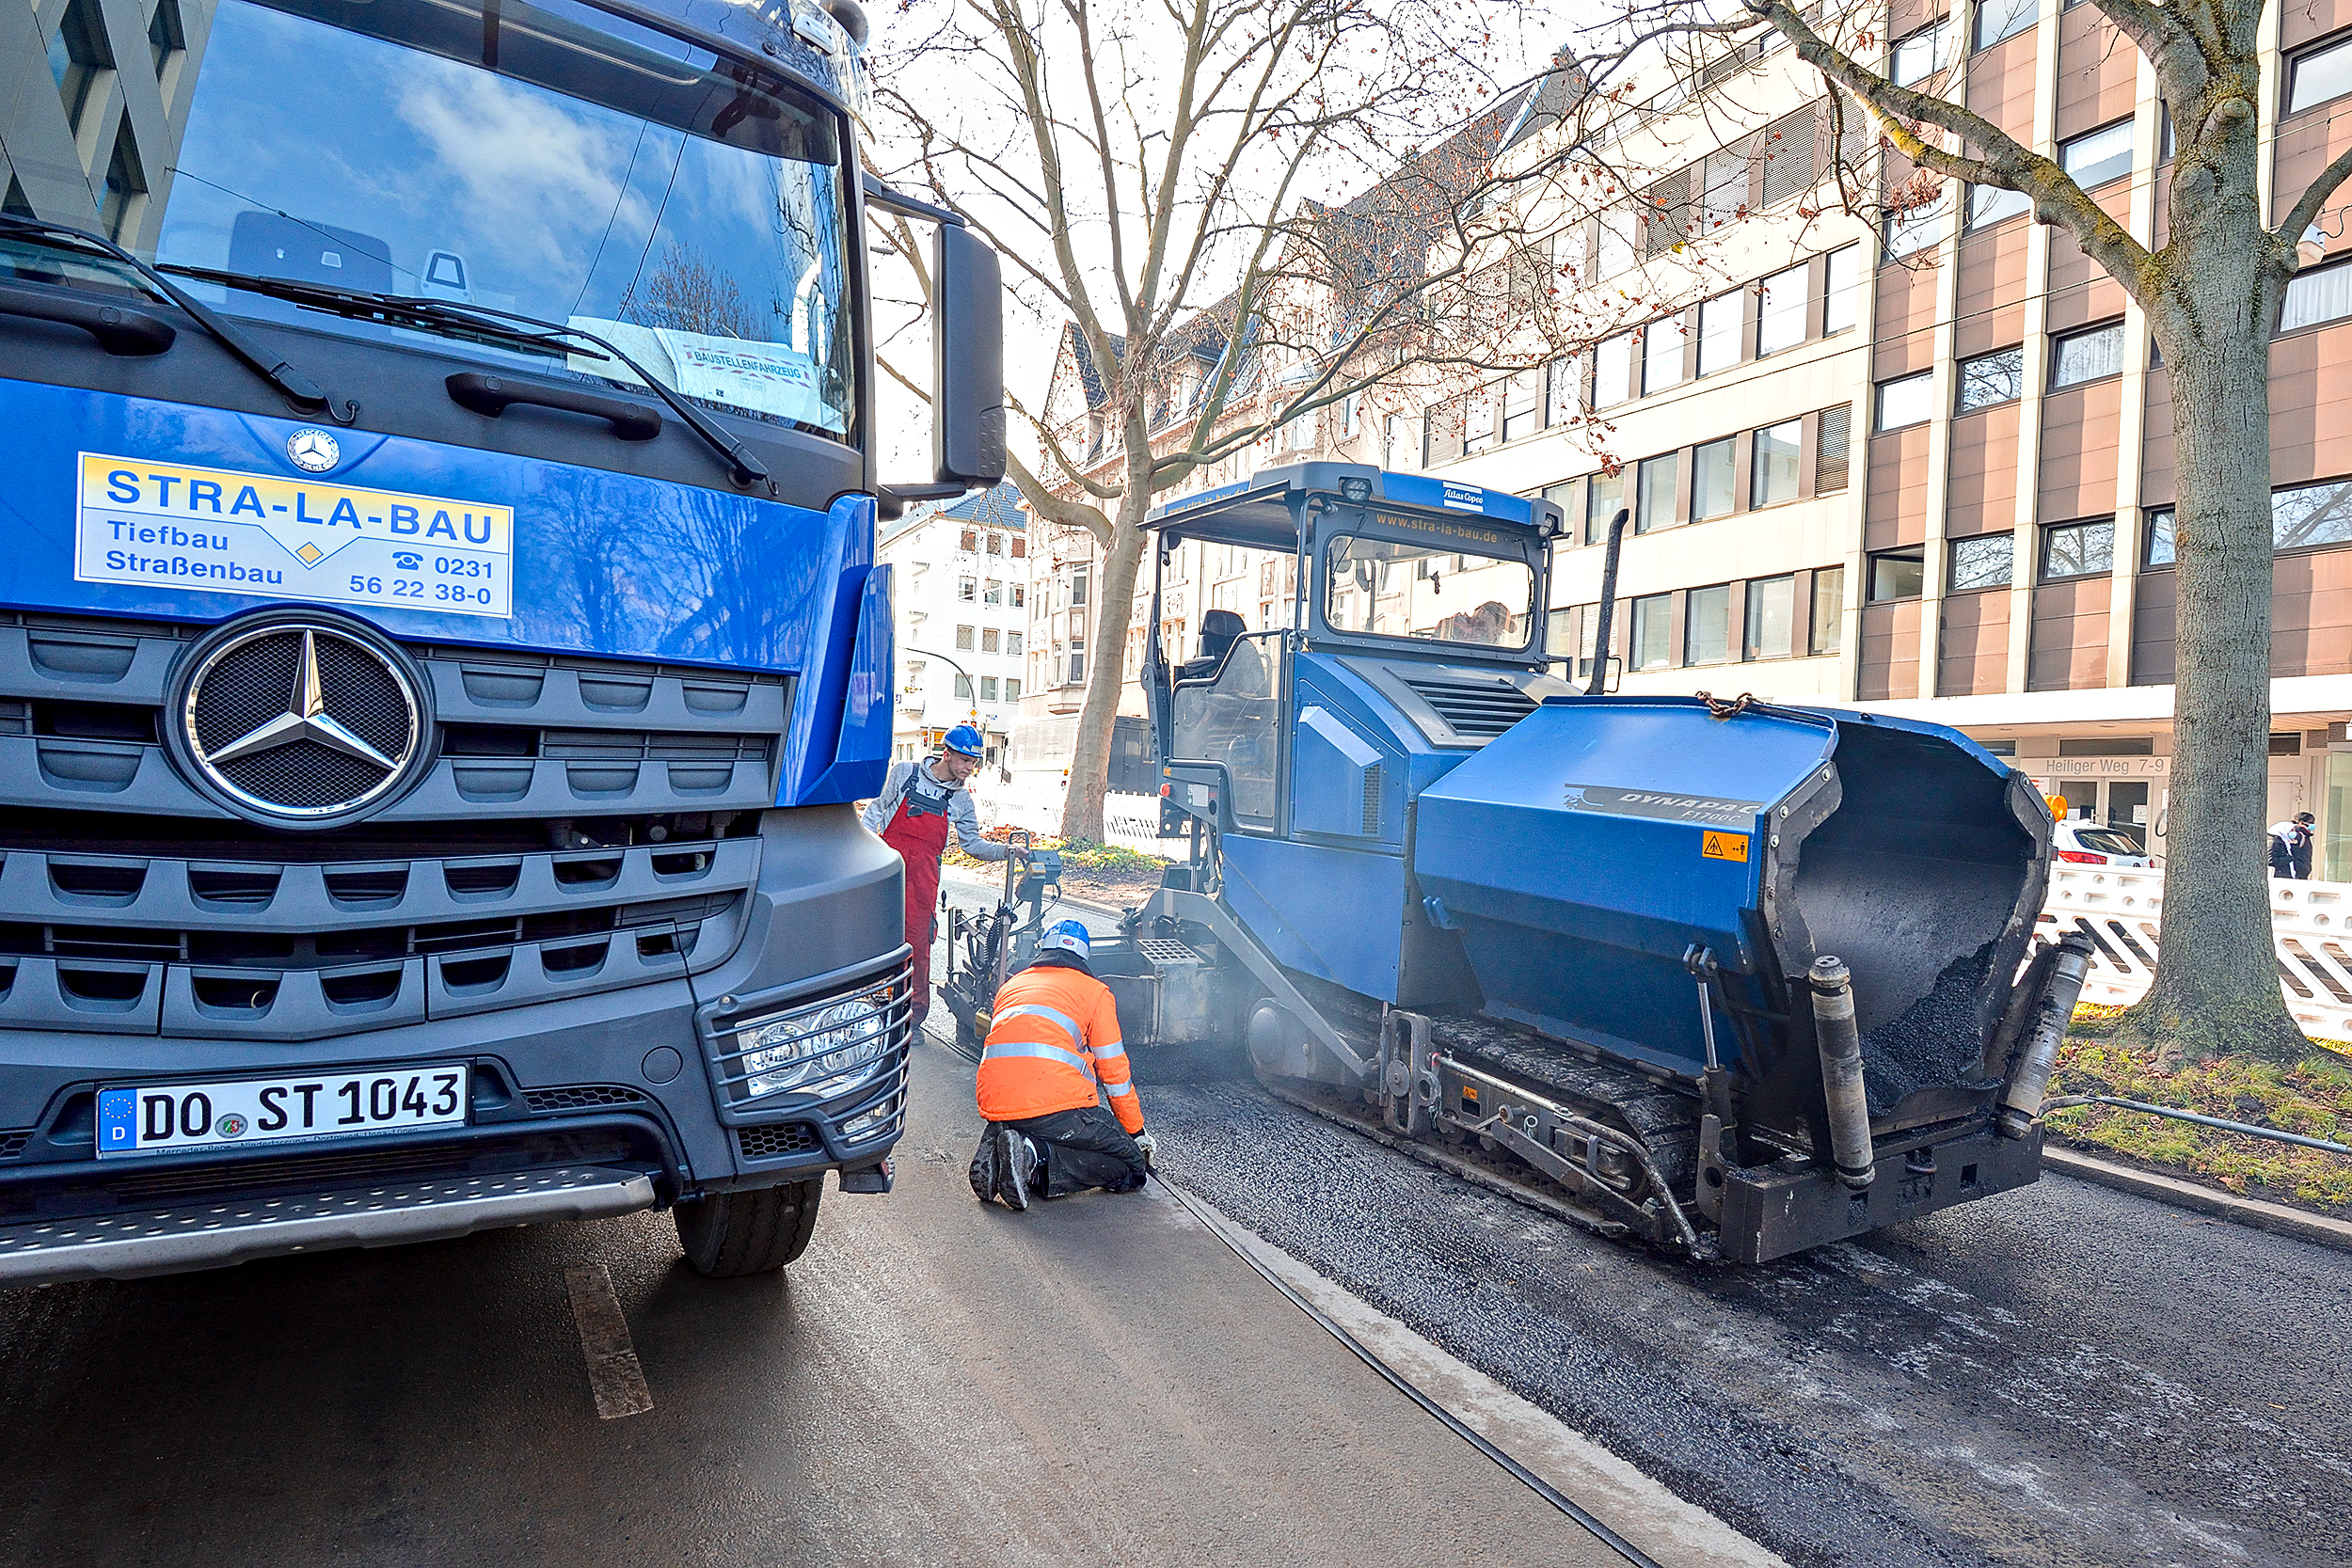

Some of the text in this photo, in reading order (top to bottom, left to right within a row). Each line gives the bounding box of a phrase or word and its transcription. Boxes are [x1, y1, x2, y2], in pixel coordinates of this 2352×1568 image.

[694, 351, 802, 378] BAUSTELLENFAHRZEUG
[106, 470, 492, 545] STRA-LA-BAU
[1443, 489, 1484, 504] Atlas Copco
[107, 520, 228, 550] Tiefbau
[1376, 514, 1497, 543] www.stra-la-bau.de
[106, 550, 282, 585] Straßenbau
[435, 557, 493, 579] 0231
[350, 576, 491, 606] 56 22 38-0
[2046, 758, 2164, 775] Heiliger Weg 7-9
[1619, 793, 1761, 815] DYNAPAC
[1682, 810, 1741, 822] F1700C
[142, 1091, 212, 1142] DO
[258, 1084, 324, 1132] ST
[338, 1073, 459, 1125] 1043
[112, 1127, 126, 1140] D
